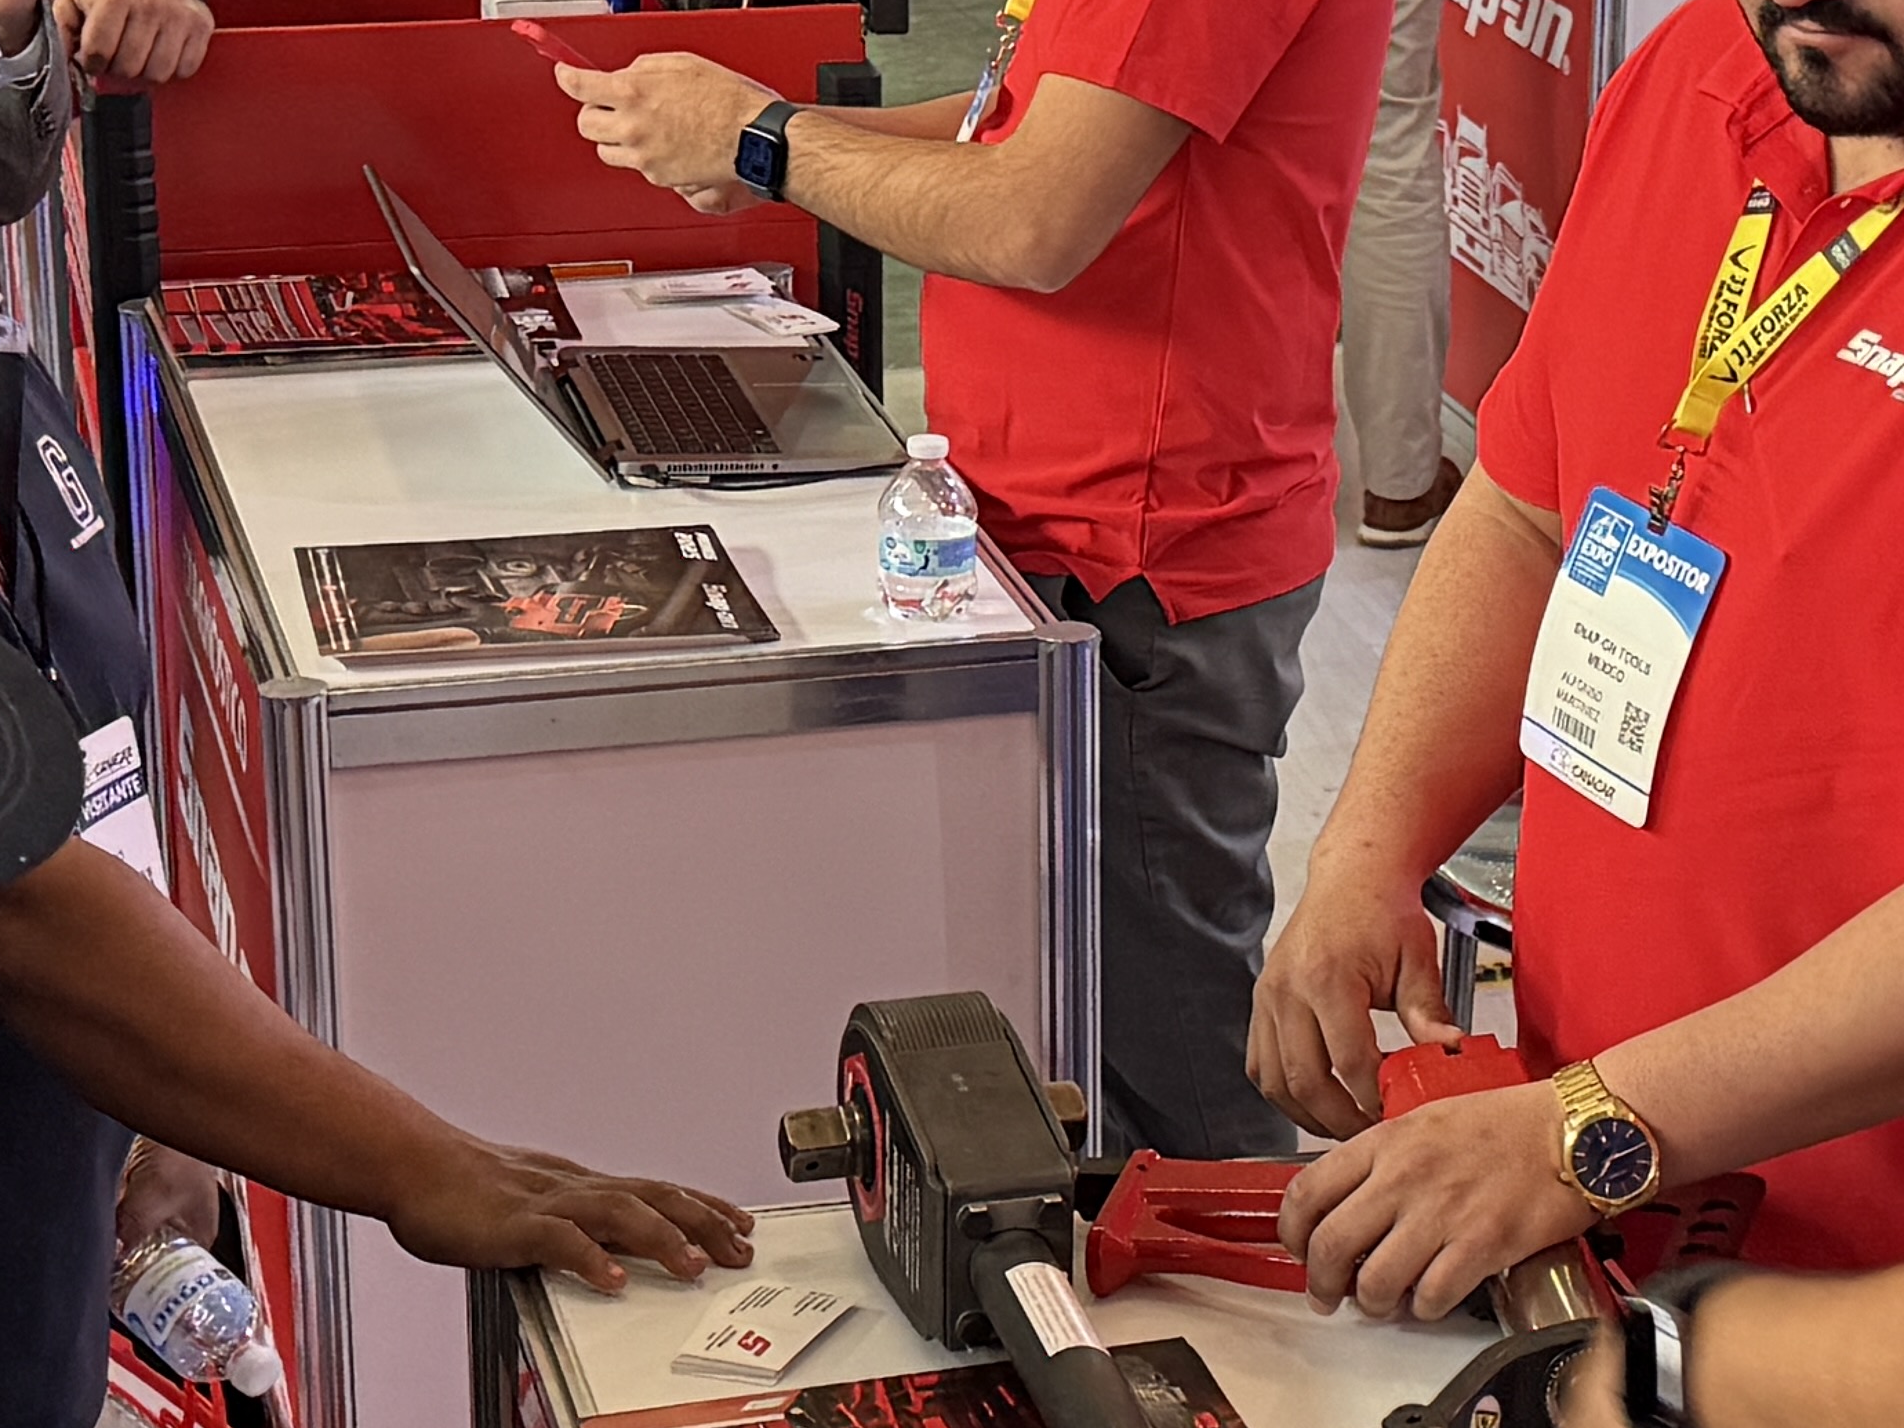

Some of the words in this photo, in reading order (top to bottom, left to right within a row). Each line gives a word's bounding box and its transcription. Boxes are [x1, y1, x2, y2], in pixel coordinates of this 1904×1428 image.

[1750, 282, 1810, 346] FORZA
[1626, 537, 1711, 596] EXPOSITOR
[177, 692, 252, 984] Snap
